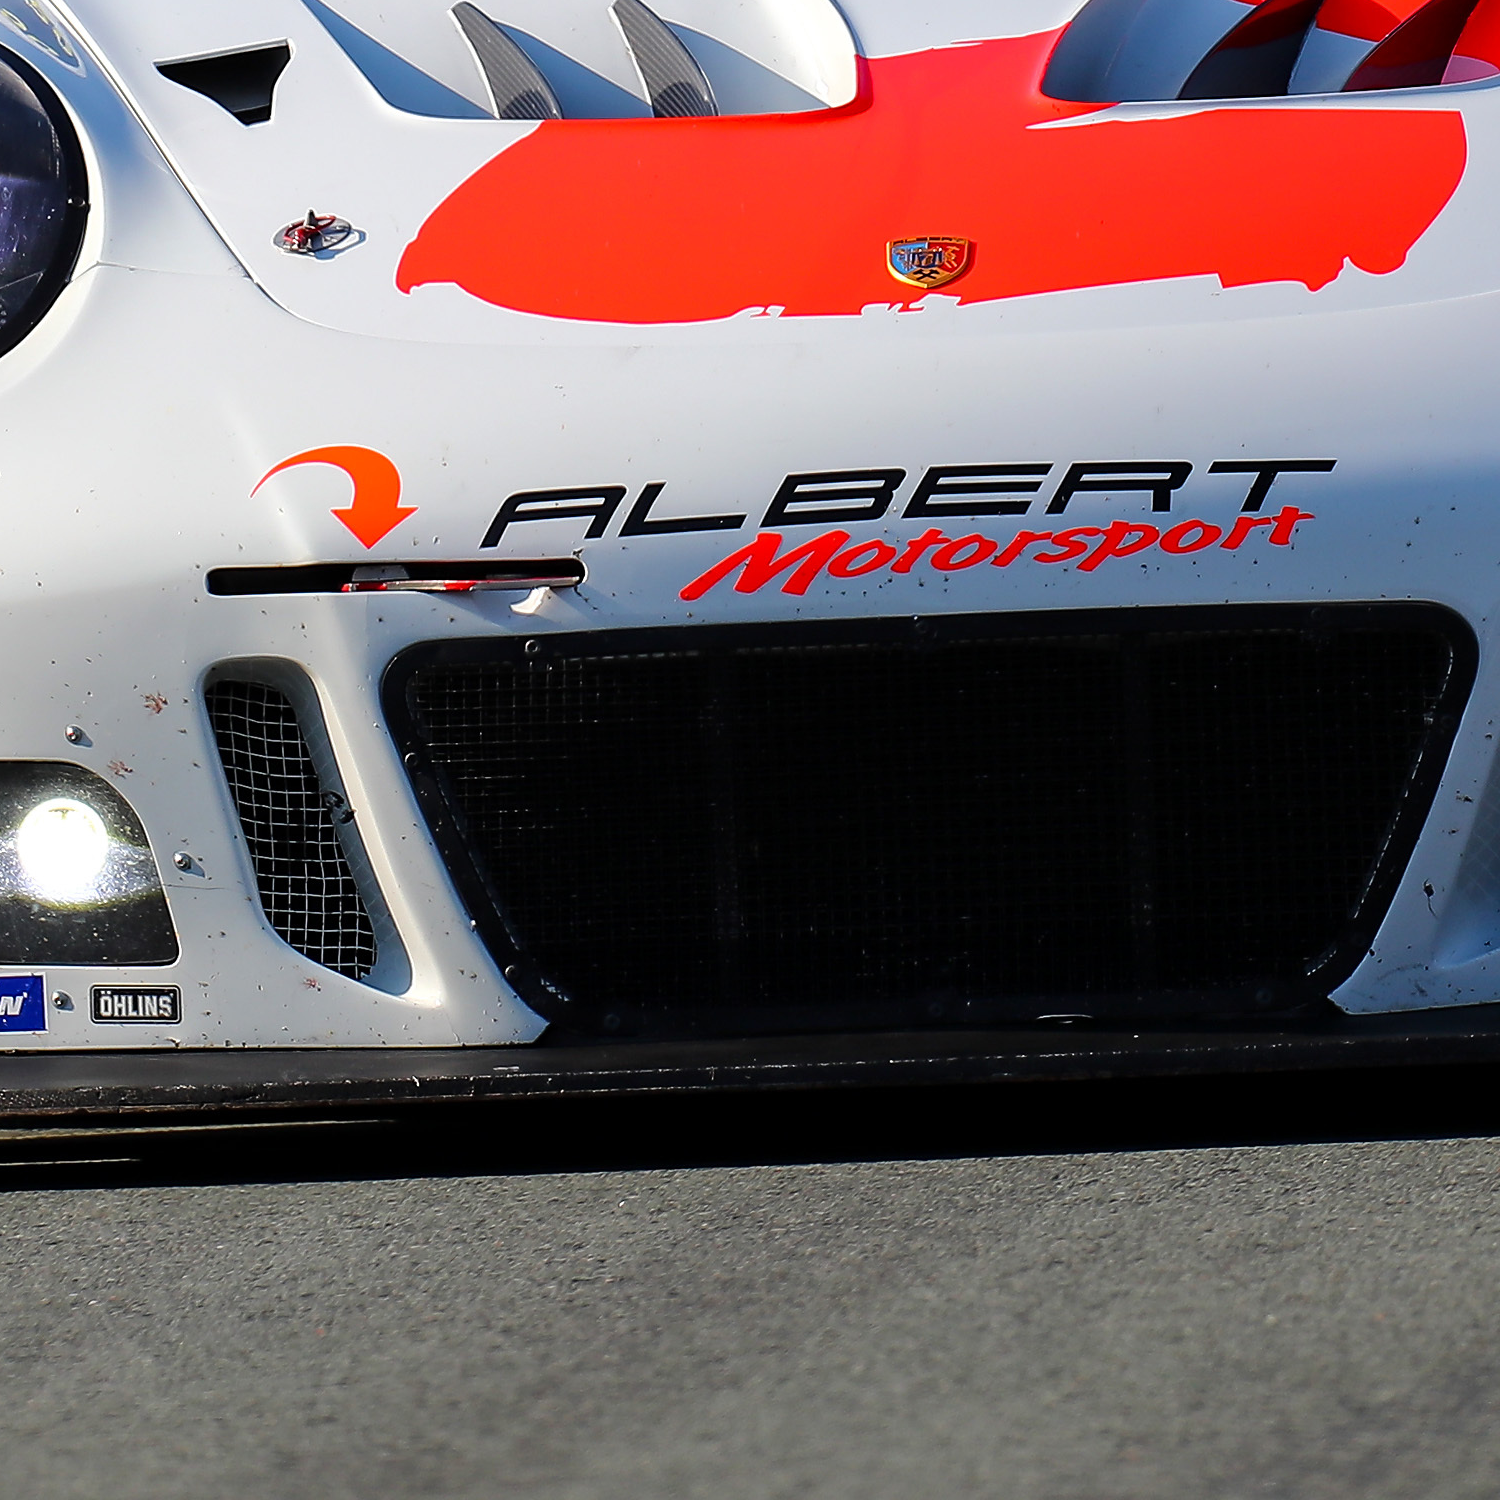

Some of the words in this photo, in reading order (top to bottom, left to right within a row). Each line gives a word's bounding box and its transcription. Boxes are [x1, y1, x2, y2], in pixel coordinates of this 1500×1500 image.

[479, 457, 1338, 550] ALBERT
[678, 505, 1315, 602] Motorsport
[98, 989, 173, 1018] ÖHLINS
